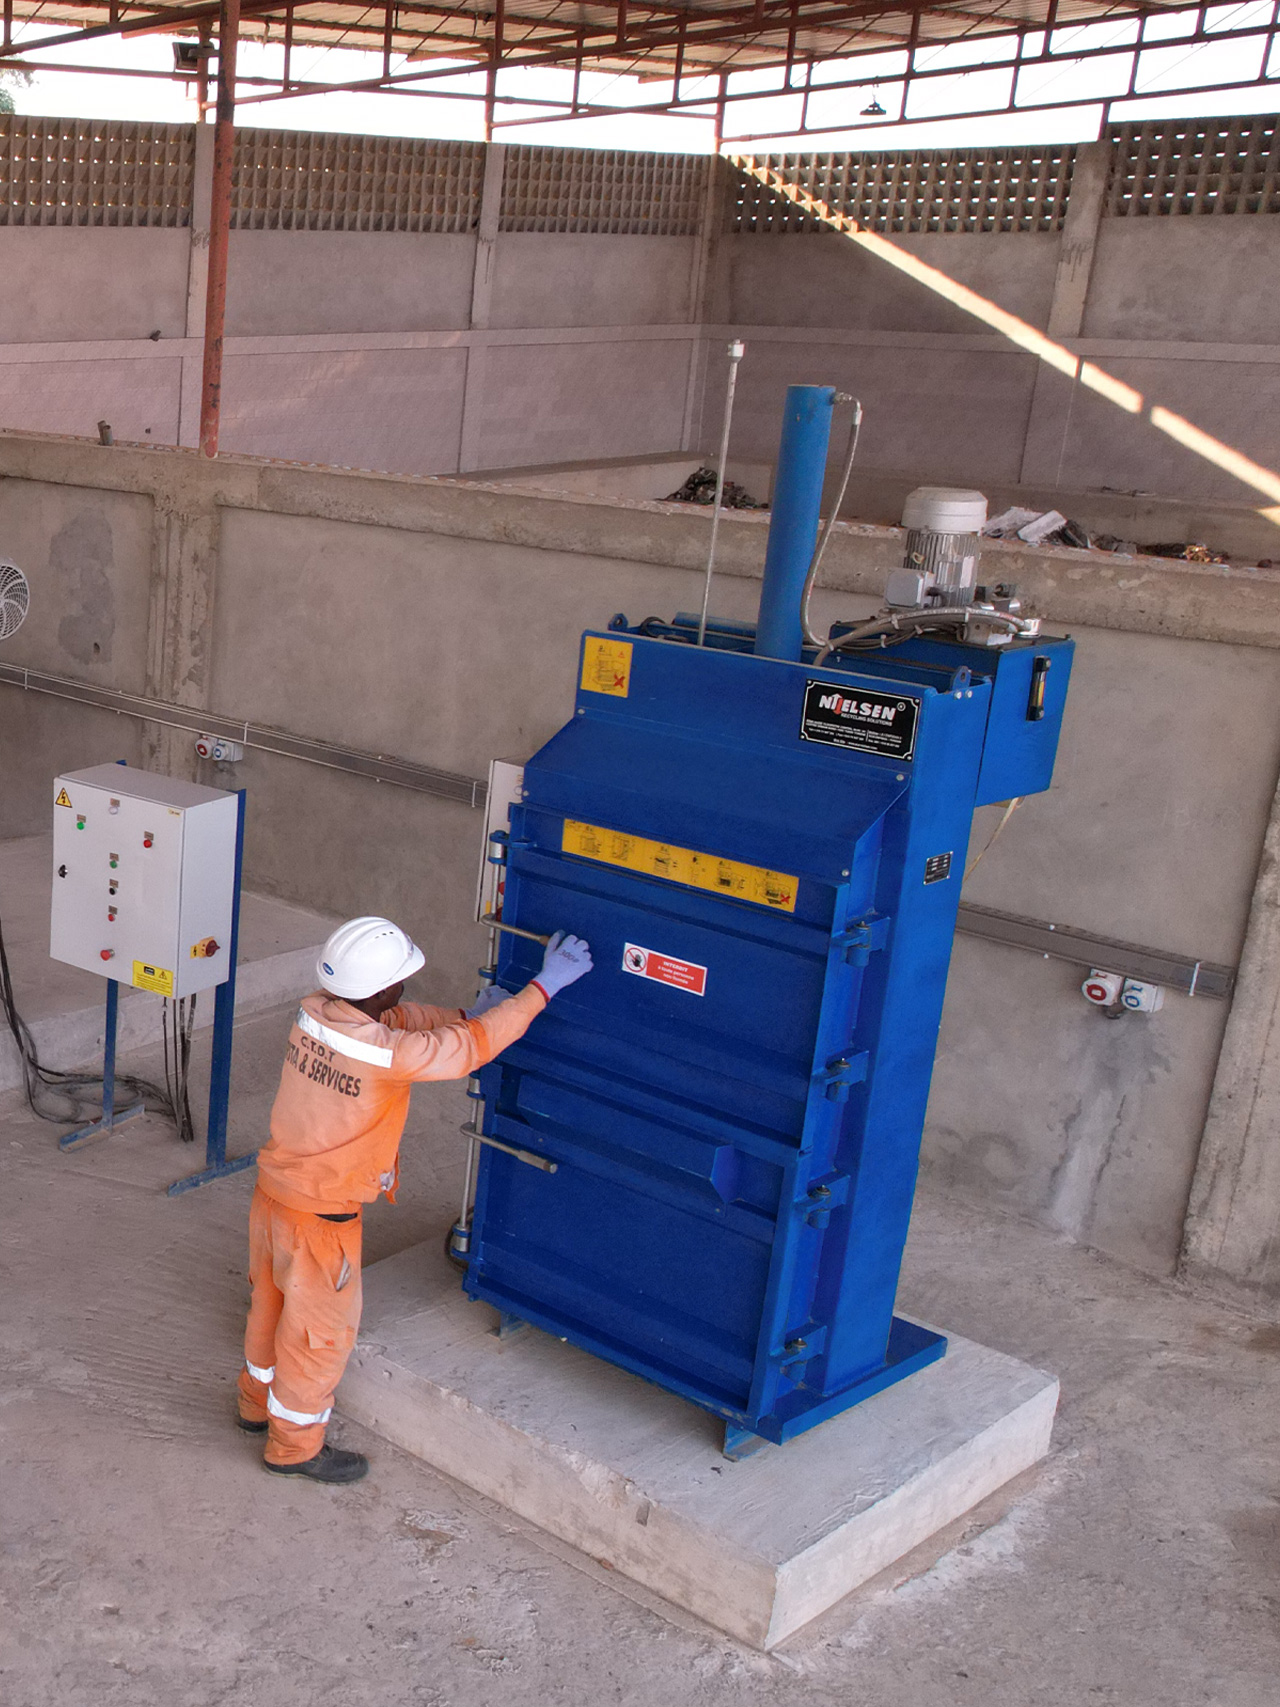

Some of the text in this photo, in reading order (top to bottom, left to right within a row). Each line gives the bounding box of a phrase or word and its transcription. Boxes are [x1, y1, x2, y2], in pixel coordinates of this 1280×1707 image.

[819, 693, 896, 720] NIELSEN
[841, 713, 867, 722] RECYCLING
[867, 718, 892, 726] SOLUTIONS
[663, 961, 688, 972] INTERDIT
[300, 1036, 336, 1062] C.T.D.T
[299, 1053, 308, 1074] &
[308, 1058, 361, 1097] SERVICES
